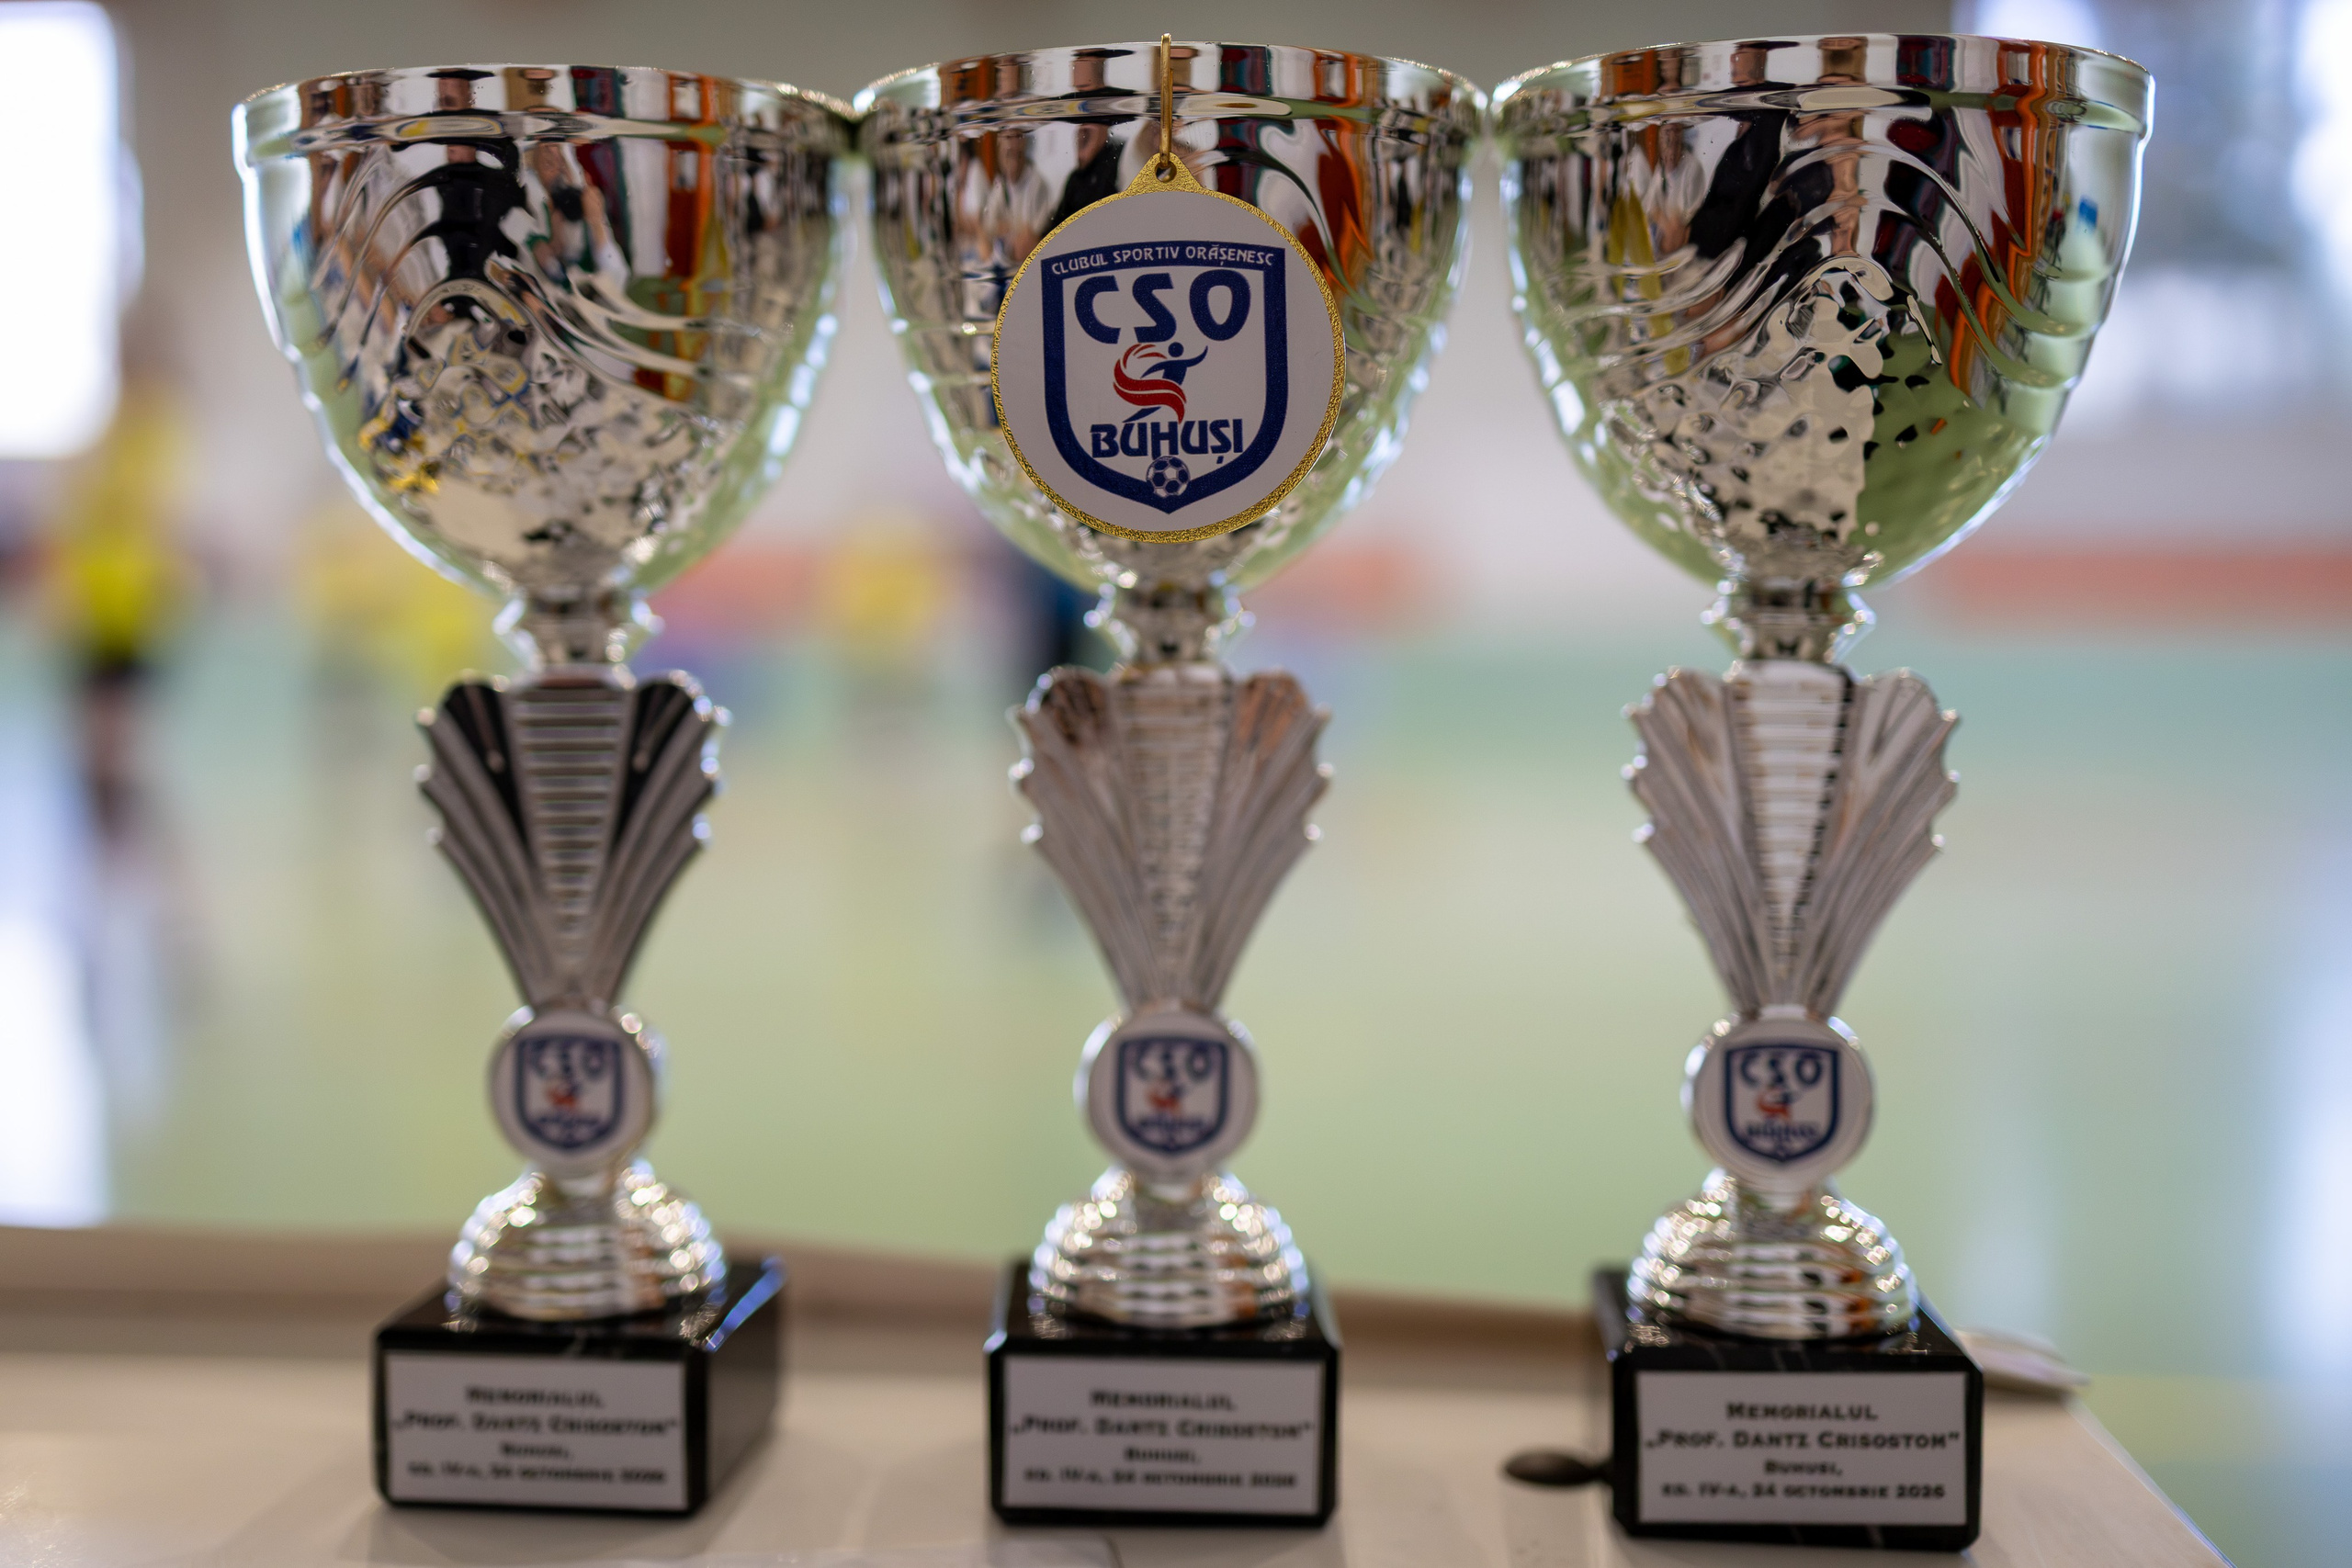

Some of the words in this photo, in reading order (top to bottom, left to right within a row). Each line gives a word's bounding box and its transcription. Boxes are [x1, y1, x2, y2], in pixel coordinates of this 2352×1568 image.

[1052, 253, 1108, 275] CLUBUL
[1114, 246, 1180, 265] SPORTIV
[1185, 243, 1274, 266] ORĂȘENESC
[1074, 269, 1251, 344] CSO
